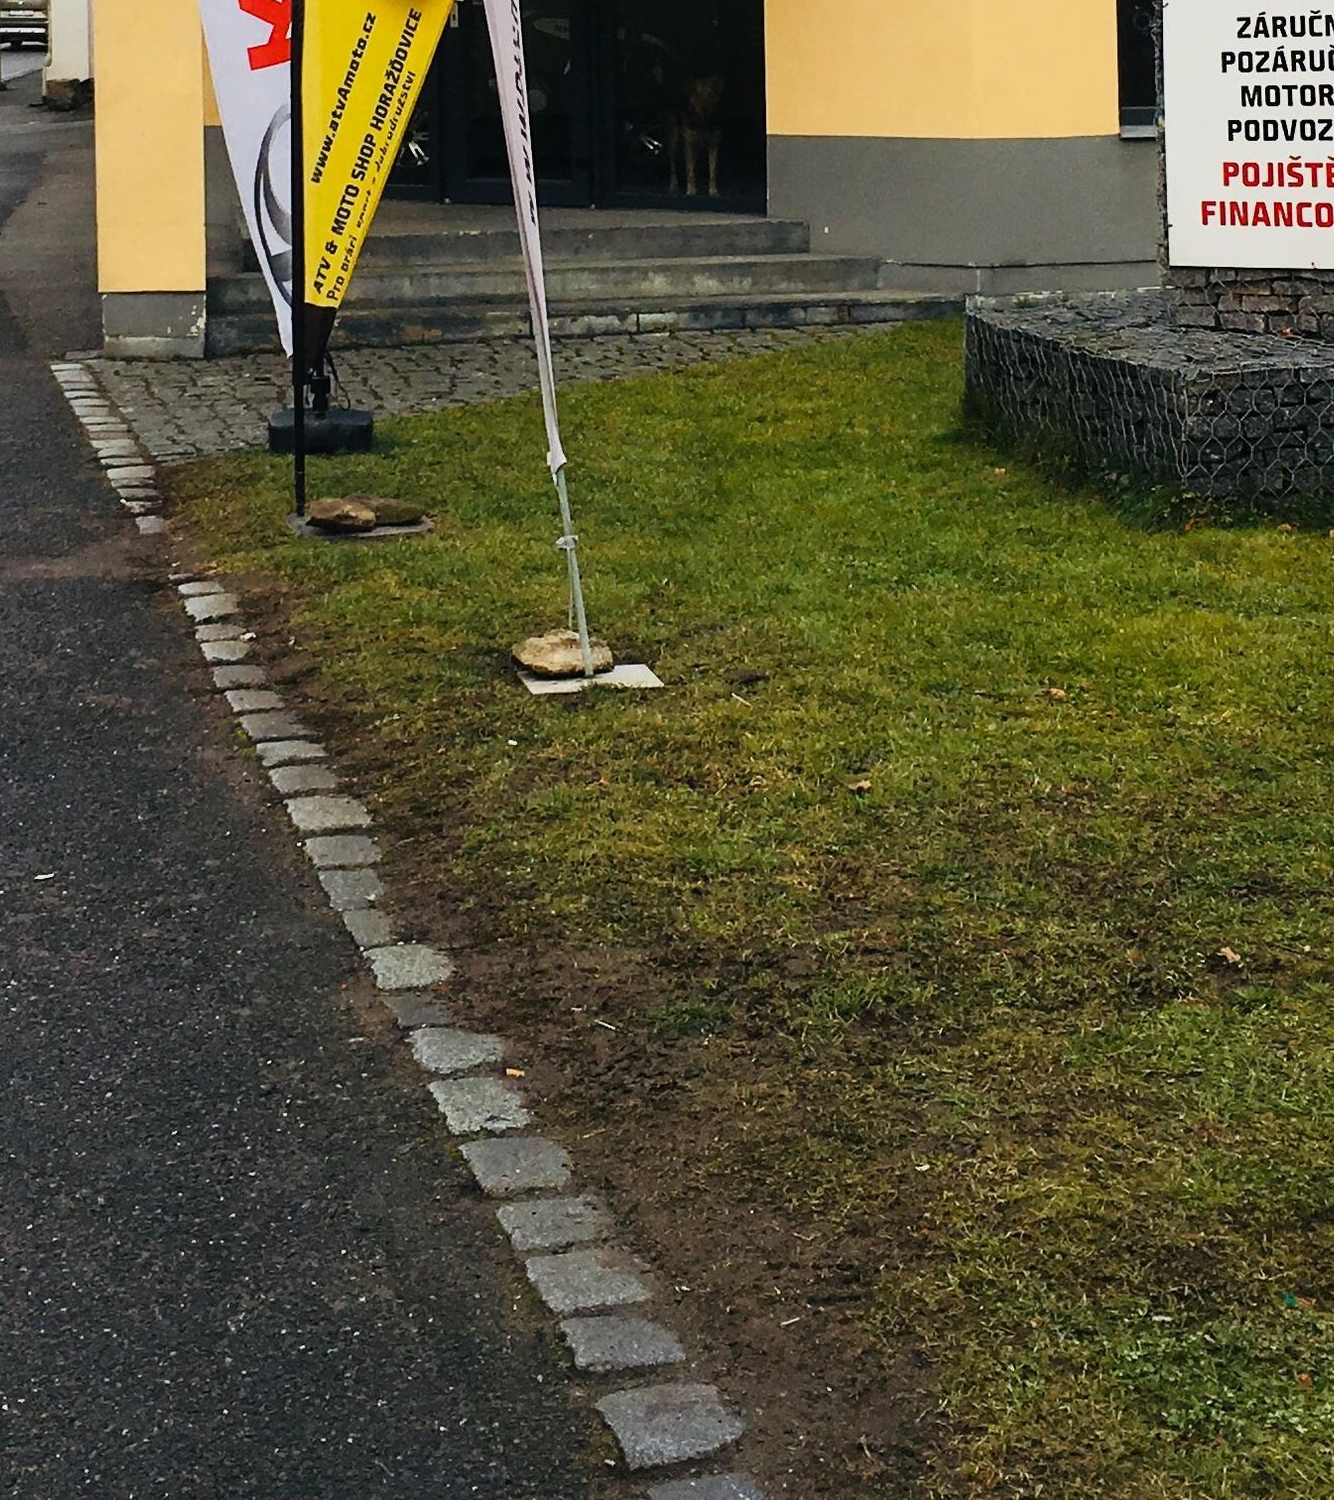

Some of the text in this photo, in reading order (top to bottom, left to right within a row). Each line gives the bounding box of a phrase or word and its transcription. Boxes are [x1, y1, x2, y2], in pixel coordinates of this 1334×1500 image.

[311, 12, 377, 185] www.atvAmoto.cz
[315, 7, 422, 295] ATV & MOTO SHOP HORAŽĎOVICE
[327, 275, 345, 301] Pro
